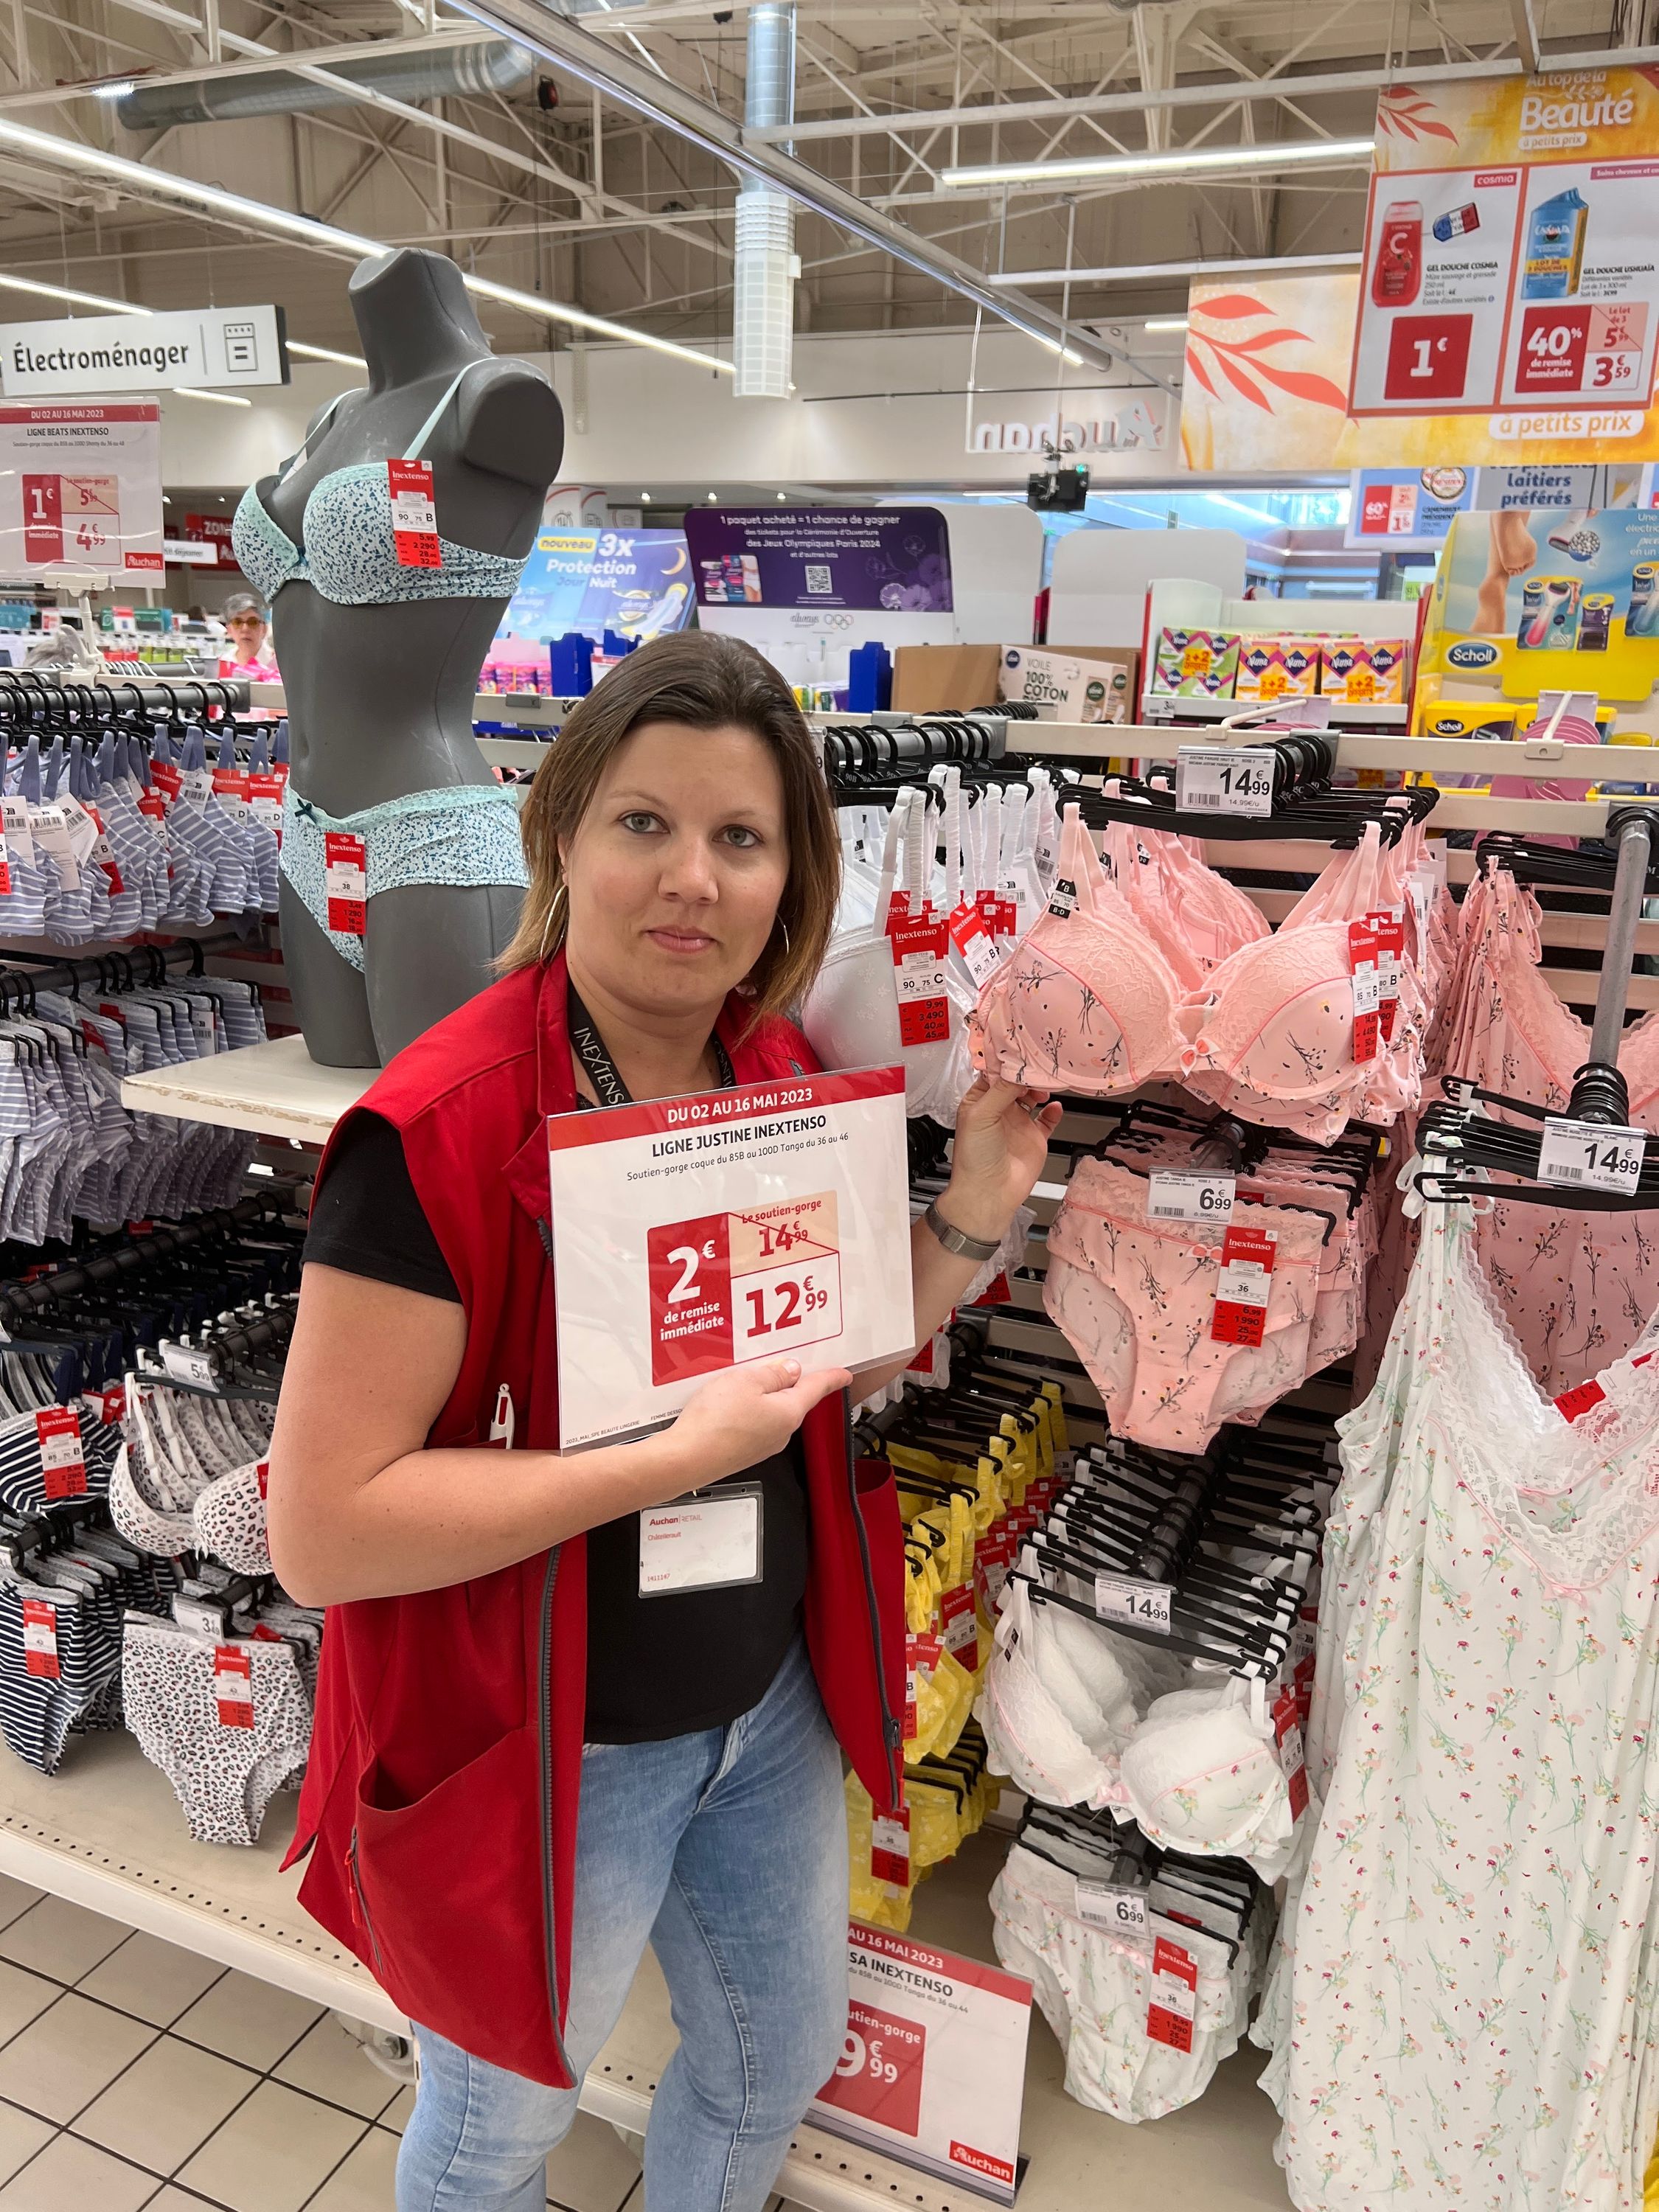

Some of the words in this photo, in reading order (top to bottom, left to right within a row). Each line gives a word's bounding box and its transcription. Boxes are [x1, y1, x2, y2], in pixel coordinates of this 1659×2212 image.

[1526, 74, 1546, 87] Au
[1549, 72, 1571, 89] top
[1520, 88, 1634, 133] Beauté
[1531, 134, 1560, 147] petits
[1562, 133, 1582, 147] prix
[1477, 175, 1514, 185] cosmia
[1427, 264, 1439, 272] GEL
[1441, 262, 1470, 271] DOUCHE
[1471, 260, 1498, 271] COSMIA
[1596, 266, 1623, 274] DOUCHE
[1527, 325, 1582, 357] 40%
[13, 341, 189, 374] Électroménager
[1531, 359, 1542, 368] de
[1543, 358, 1572, 367] remise
[1526, 369, 1573, 379] immédiate
[31, 411, 41, 420] DU
[42, 410, 51, 419] 02
[52, 410, 62, 419] AU
[63, 409, 71, 419] 16
[72, 409, 86, 418] MAI
[86, 409, 104, 418] 2023
[27, 428, 46, 437] LIGNE
[47, 428, 69, 437] BEATS
[70, 427, 109, 436] INEXTENSO
[1499, 413, 1512, 434] à
[1519, 412, 1582, 439] petits
[1588, 412, 1632, 438] prix
[392, 470, 429, 481] Inextenso
[1507, 472, 1571, 487] laitiers
[1500, 490, 1572, 509] préférés
[426, 513, 434, 522] B
[727, 516, 762, 526] paquet
[762, 515, 796, 524] acheté
[812, 515, 848, 524] chance
[849, 515, 863, 524] de
[864, 516, 900, 526] gagner
[540, 539, 593, 549] nouveau
[599, 533, 636, 557] 3x
[746, 539, 762, 547] des
[784, 539, 835, 549] Olympiques
[835, 540, 858, 548] Paris
[859, 540, 880, 548] 2024
[128, 555, 161, 567] Auchan
[546, 560, 637, 575] Protection
[556, 577, 585, 587] Jour
[589, 577, 618, 588] Nuit
[1452, 647, 1493, 664] Scholl
[1027, 658, 1051, 672] VOILE
[1023, 684, 1069, 703] COTON
[1437, 720, 1463, 732] Scholl
[100, 844, 108, 853] B
[329, 843, 361, 852] Inextenso
[952, 911, 977, 934] Inextenso
[894, 928, 937, 942] Inextenso
[1377, 926, 1398, 936] tenso
[1350, 936, 1375, 947] Inextenso
[989, 948, 996, 959] B
[903, 980, 915, 989] 90
[933, 973, 944, 984] C
[1390, 974, 1397, 985] B
[1373, 985, 1377, 996] B
[574, 1026, 625, 1105] INEXTENS
[667, 1107, 688, 1124] DU
[690, 1104, 709, 1120] 02
[712, 1101, 732, 1116] AU
[734, 1097, 751, 1113] 16
[753, 1093, 778, 1110] MAI
[780, 1088, 813, 1105] 2023
[652, 1137, 693, 1158] LIGNE
[696, 1127, 752, 1150] JUSTINE
[754, 1115, 827, 1140] INEXTENSO
[627, 1162, 689, 1181] Soutien-gorge
[690, 1158, 714, 1170] coque
[717, 1155, 728, 1165] du
[729, 1152, 745, 1162] 85B
[746, 1150, 757, 1159] au
[758, 1145, 779, 1157] 100D
[780, 1141, 804, 1153] Tanga
[806, 1138, 815, 1147] du
[818, 1136, 827, 1145] 36
[828, 1135, 838, 1144] au
[839, 1132, 849, 1141] 46
[741, 1211, 753, 1225] Le
[754, 1198, 822, 1222] soutien-gorge
[1228, 1238, 1271, 1251] Inextenso
[1237, 1284, 1249, 1293] 36
[663, 1311, 678, 1325] de
[681, 1300, 720, 1322] remise
[660, 1314, 725, 1341] immédiate
[601, 1425, 619, 1436] BEAUTE
[619, 1420, 640, 1430] LINGERIE
[650, 1412, 667, 1422] FEMME
[650, 1517, 678, 1526] Auchan
[969, 1624, 975, 1633] B
[848, 1927, 865, 1941] AU
[867, 1934, 882, 1948] 16
[884, 1939, 908, 1958] MAI
[910, 1949, 944, 1969] 2023
[1158, 1948, 1194, 1972] Inextenso
[849, 1952, 868, 1968] SA
[871, 1958, 953, 1997] INEXTENSO
[904, 1985, 926, 1999] Tanga
[927, 1994, 937, 2003] du
[959, 2005, 969, 2014] 44
[849, 2010, 922, 2044] utien-gorge
[952, 2146, 1011, 2180] Auchan
